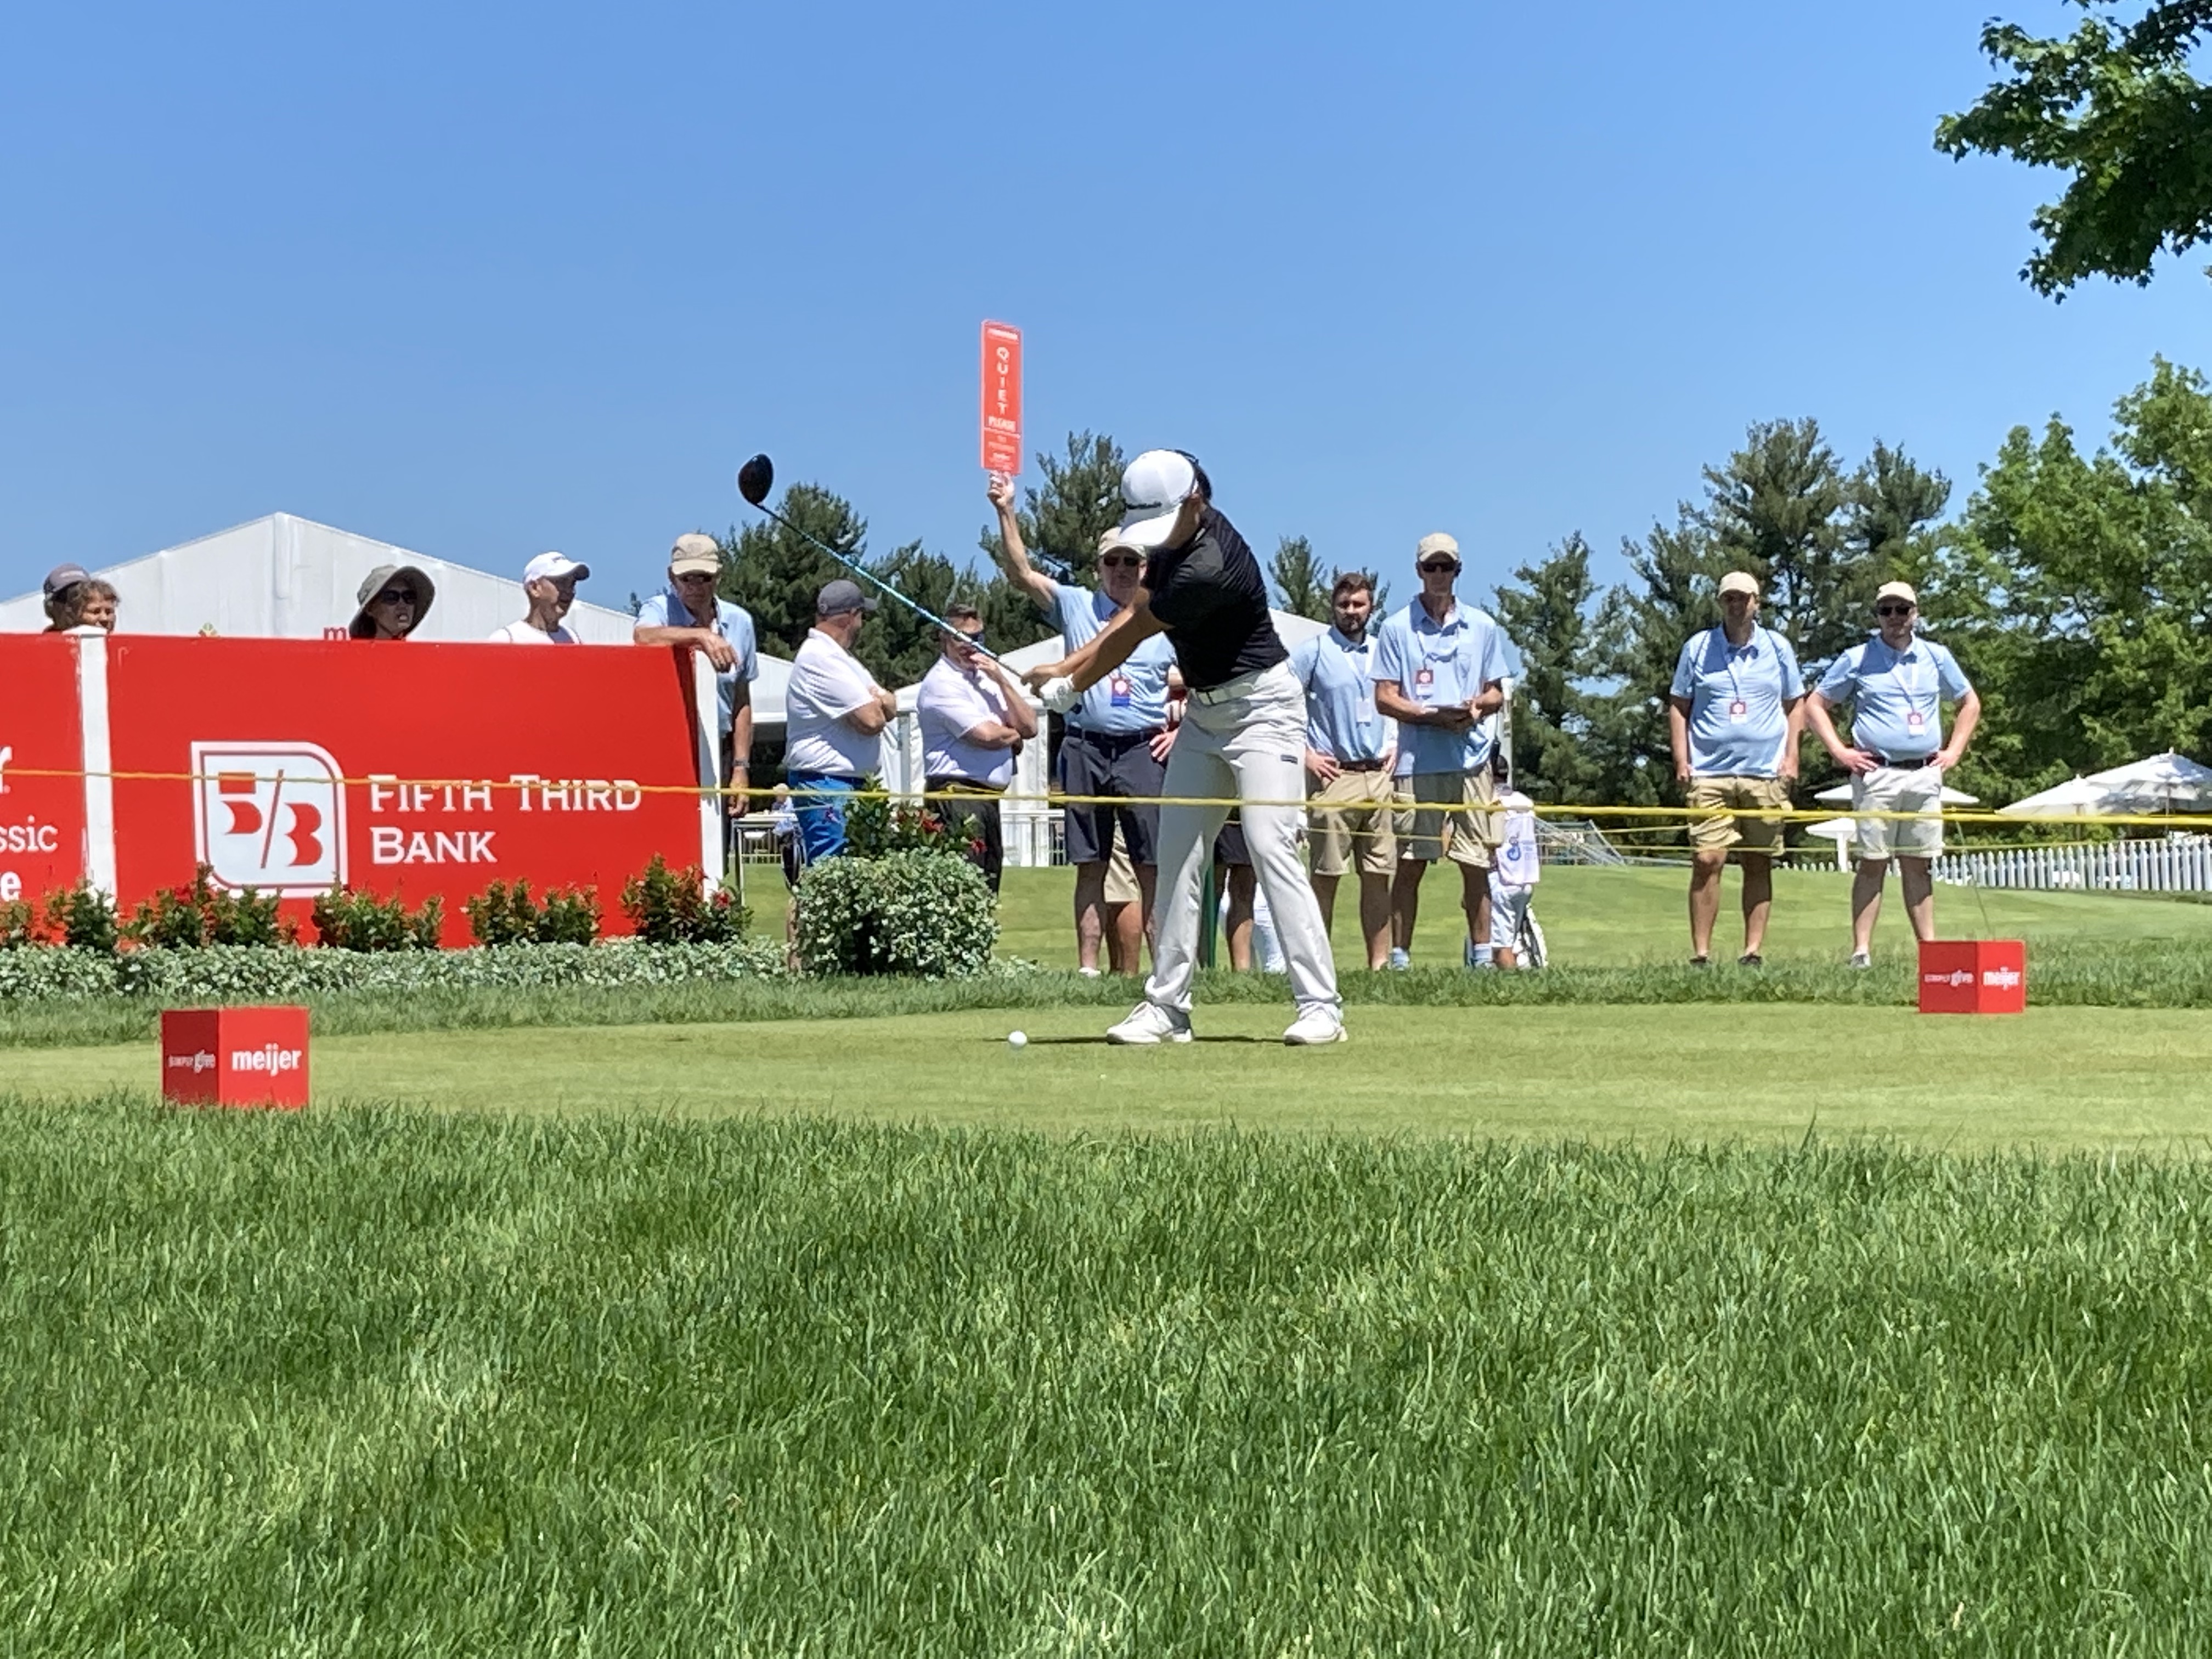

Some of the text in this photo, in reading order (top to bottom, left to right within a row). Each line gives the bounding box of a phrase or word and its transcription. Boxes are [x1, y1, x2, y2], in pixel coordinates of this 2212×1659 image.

[996, 346, 1009, 415] QUIET
[368, 774, 642, 812] FIFTH THIRD
[370, 826, 498, 864] BANK
[232, 1042, 302, 1077] meijer
